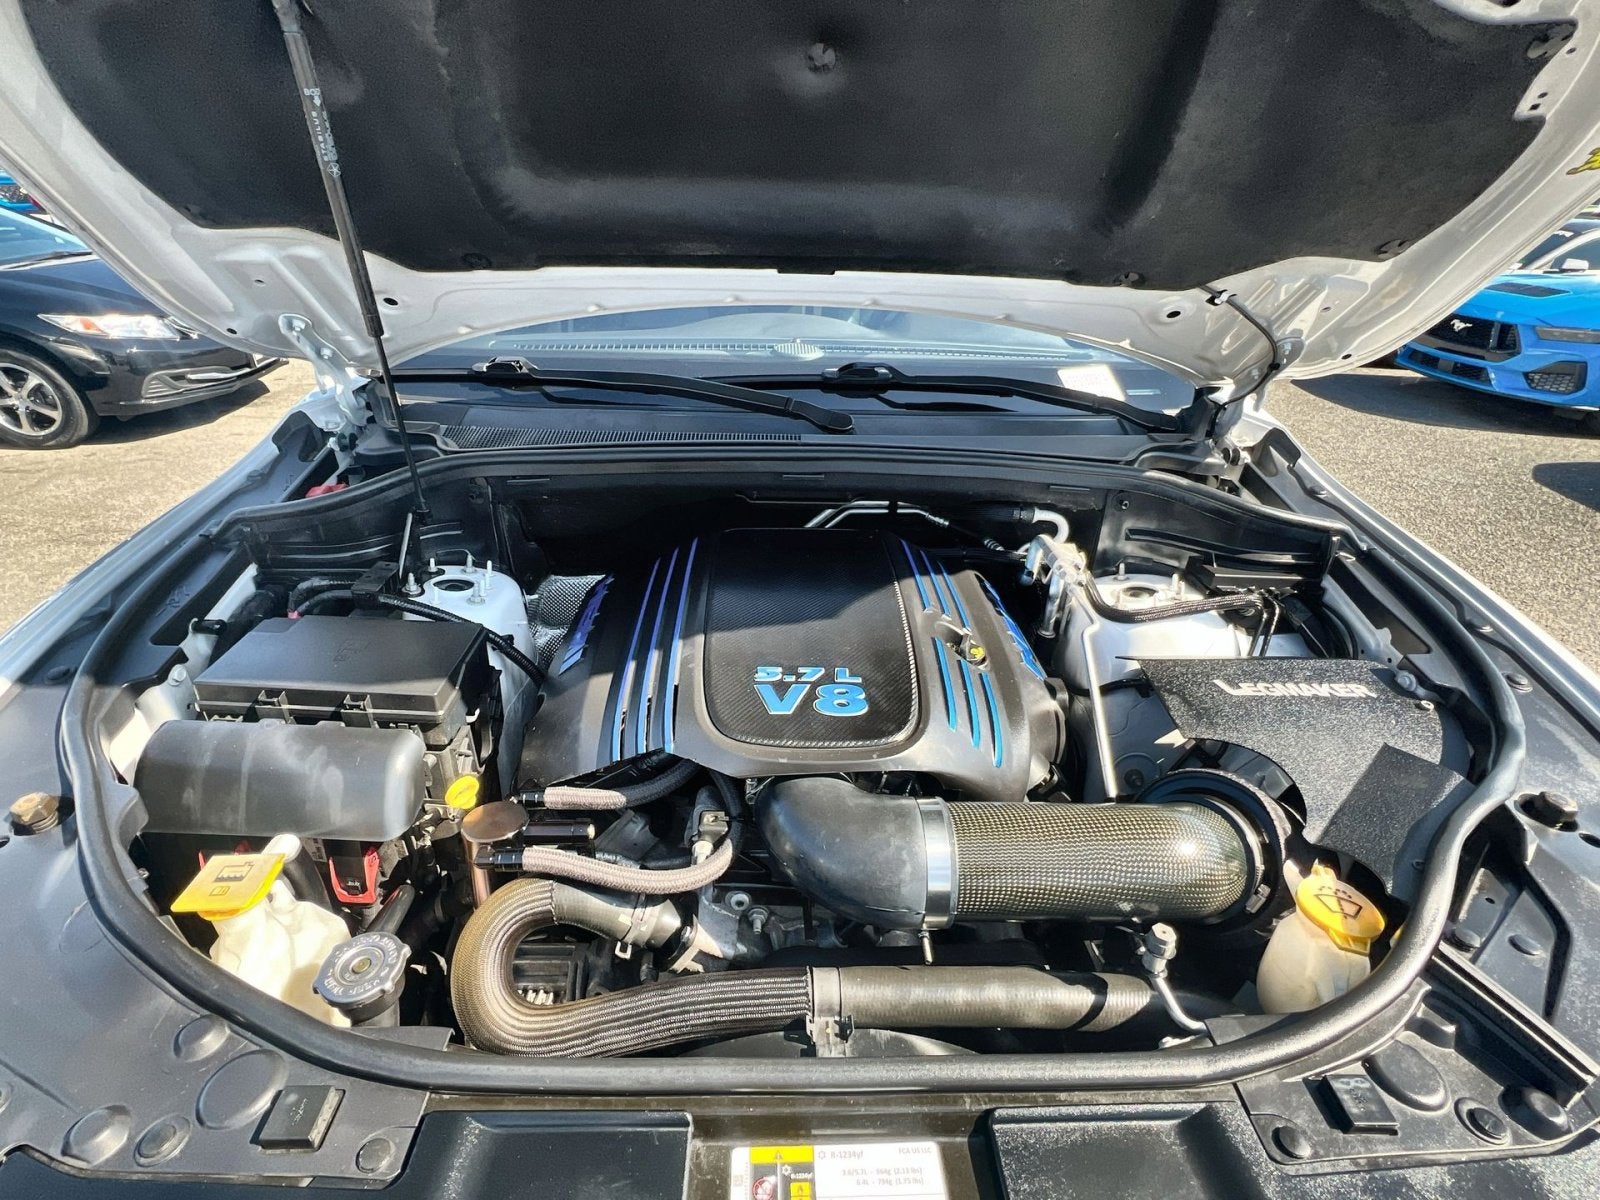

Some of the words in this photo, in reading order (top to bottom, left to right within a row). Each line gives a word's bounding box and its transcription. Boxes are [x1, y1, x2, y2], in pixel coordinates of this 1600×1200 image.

[1213, 679, 1378, 698] LEGMAKER
[753, 683, 869, 716] V8
[830, 1150, 864, 1160] R-1234yf
[898, 1147, 911, 1155] FCA
